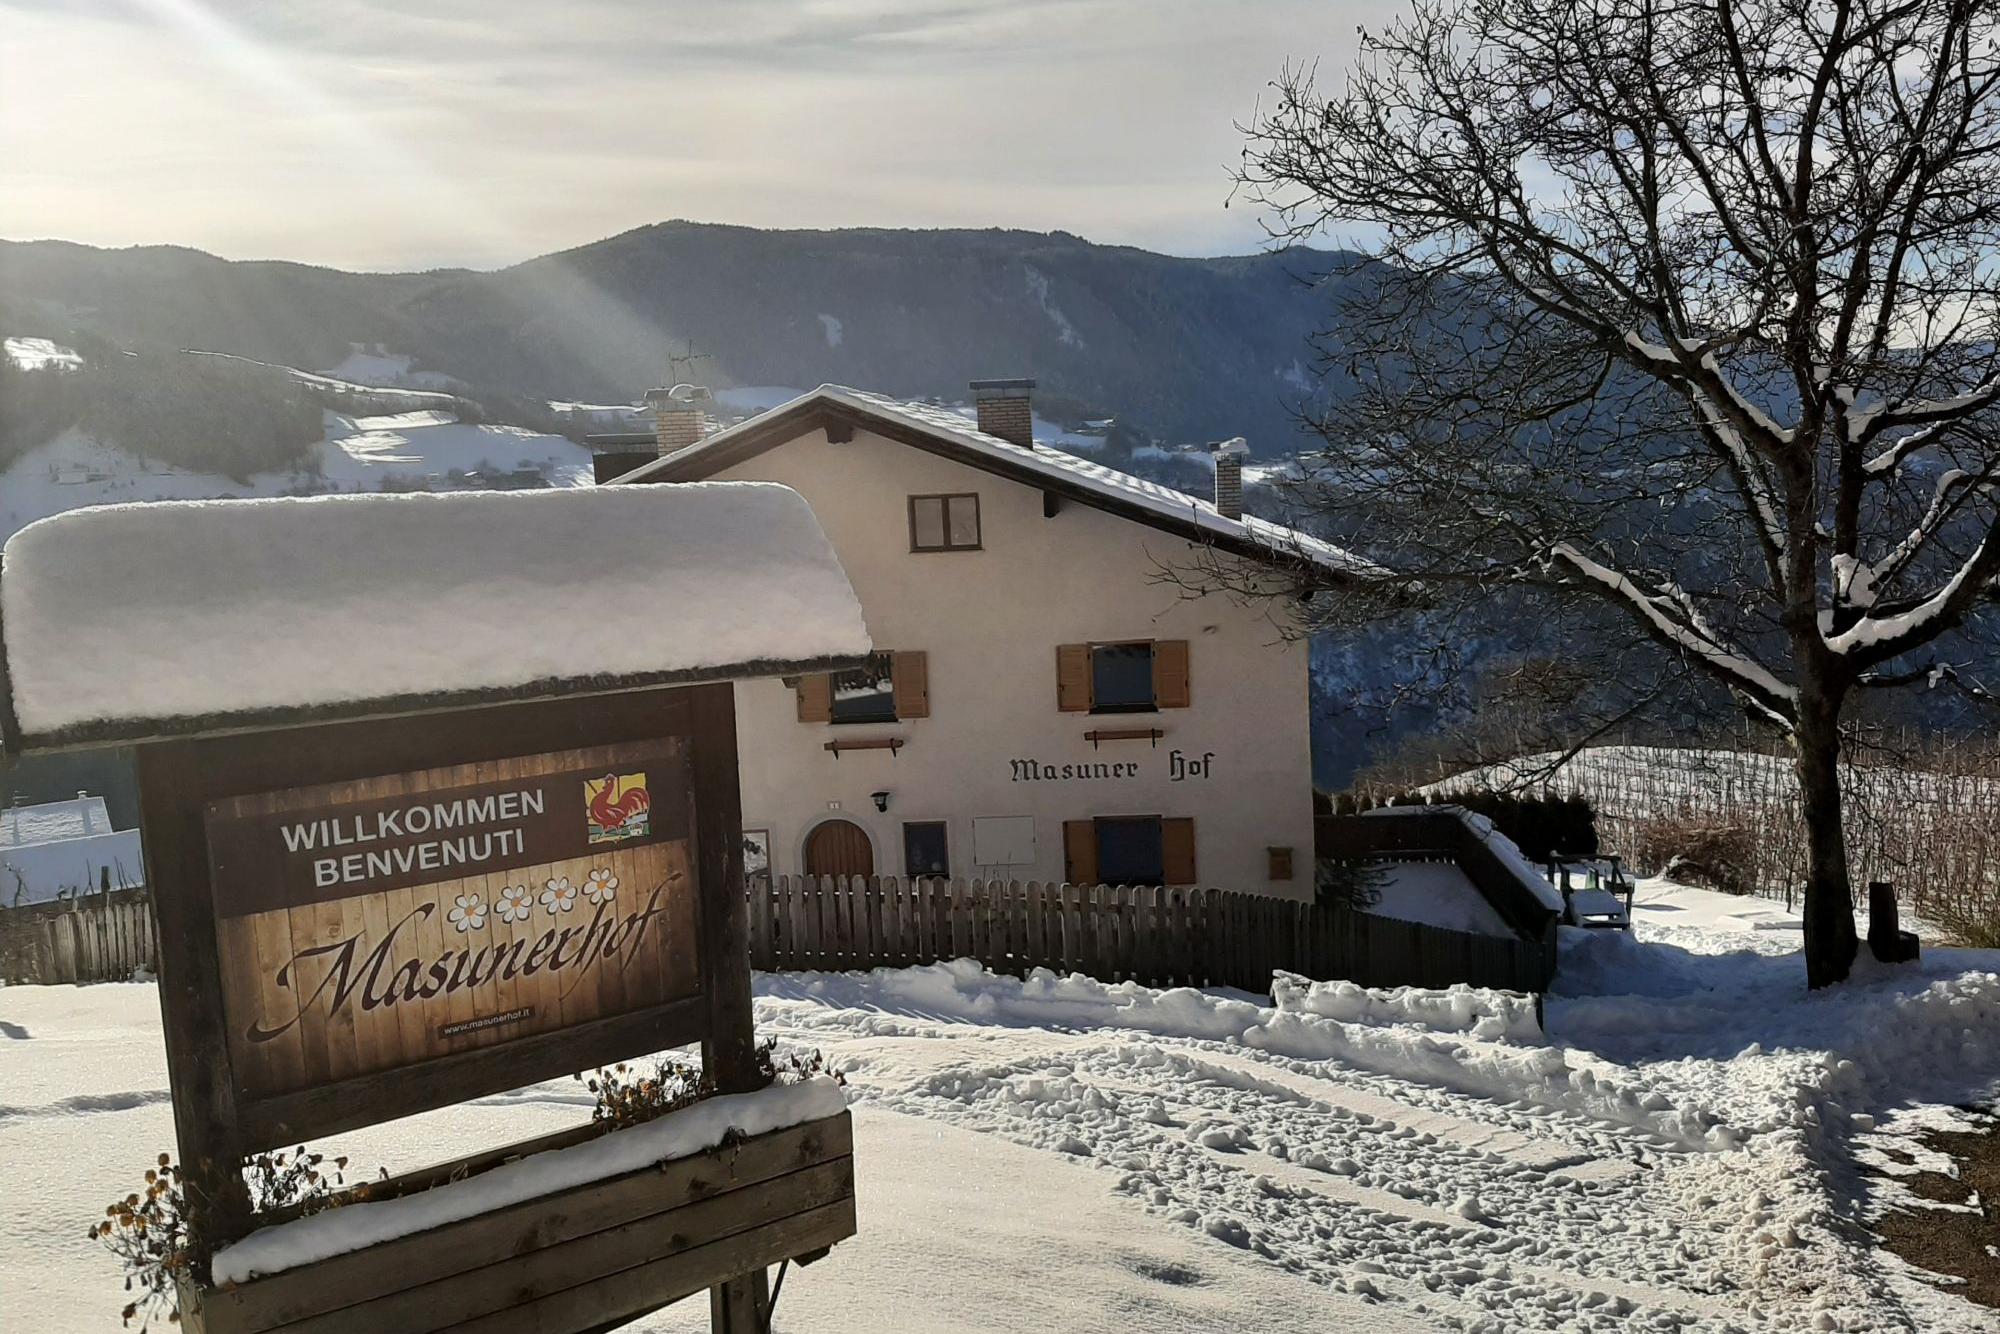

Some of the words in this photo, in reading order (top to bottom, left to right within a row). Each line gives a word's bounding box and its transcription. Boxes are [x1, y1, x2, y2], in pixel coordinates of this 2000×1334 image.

[1009, 758, 1139, 782] Masuner
[1169, 749, 1216, 782] Hof
[281, 788, 545, 852] WILLKOMMEN
[314, 828, 525, 888] BENVENUTI
[246, 872, 683, 1043] Masunerhof
[444, 1008, 530, 1035] www.masunerhof.it
